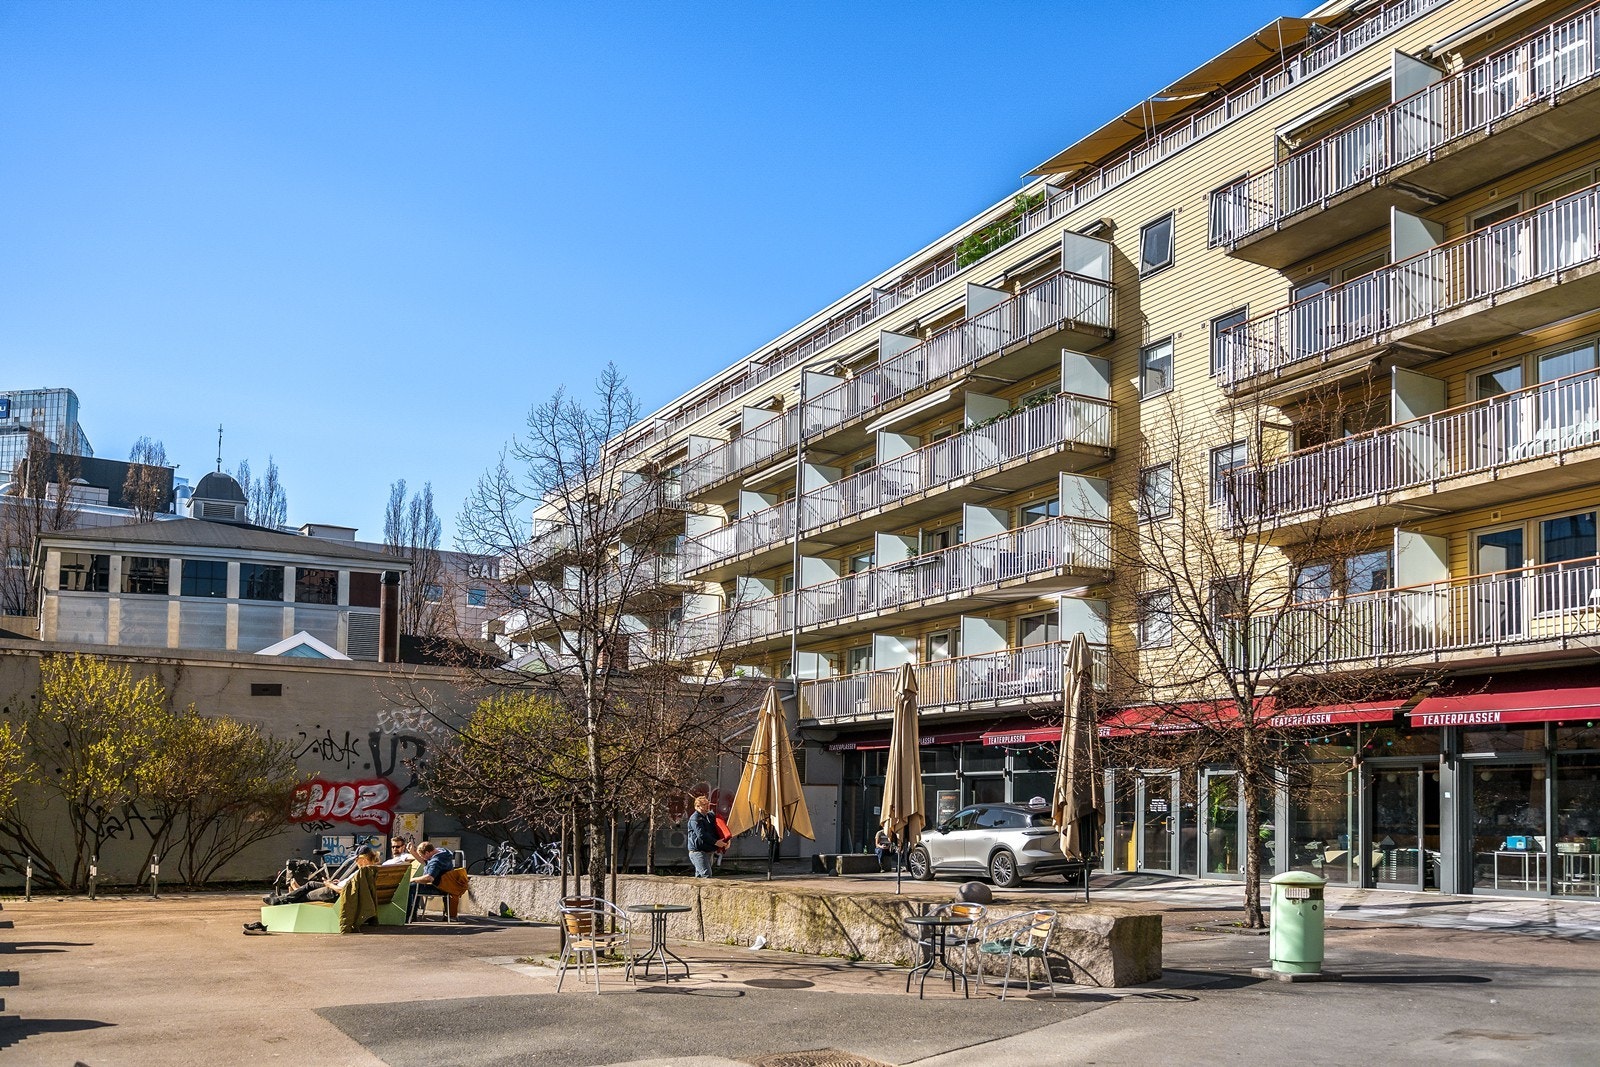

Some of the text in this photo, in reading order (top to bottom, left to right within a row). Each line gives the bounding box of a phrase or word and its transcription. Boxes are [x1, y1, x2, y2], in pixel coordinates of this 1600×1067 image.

[1271, 714, 1331, 727] TEATERPLASSEN
[1423, 712, 1501, 725] TEATERPLASSEN
[988, 735, 1026, 745] TEATERPLASSEN
